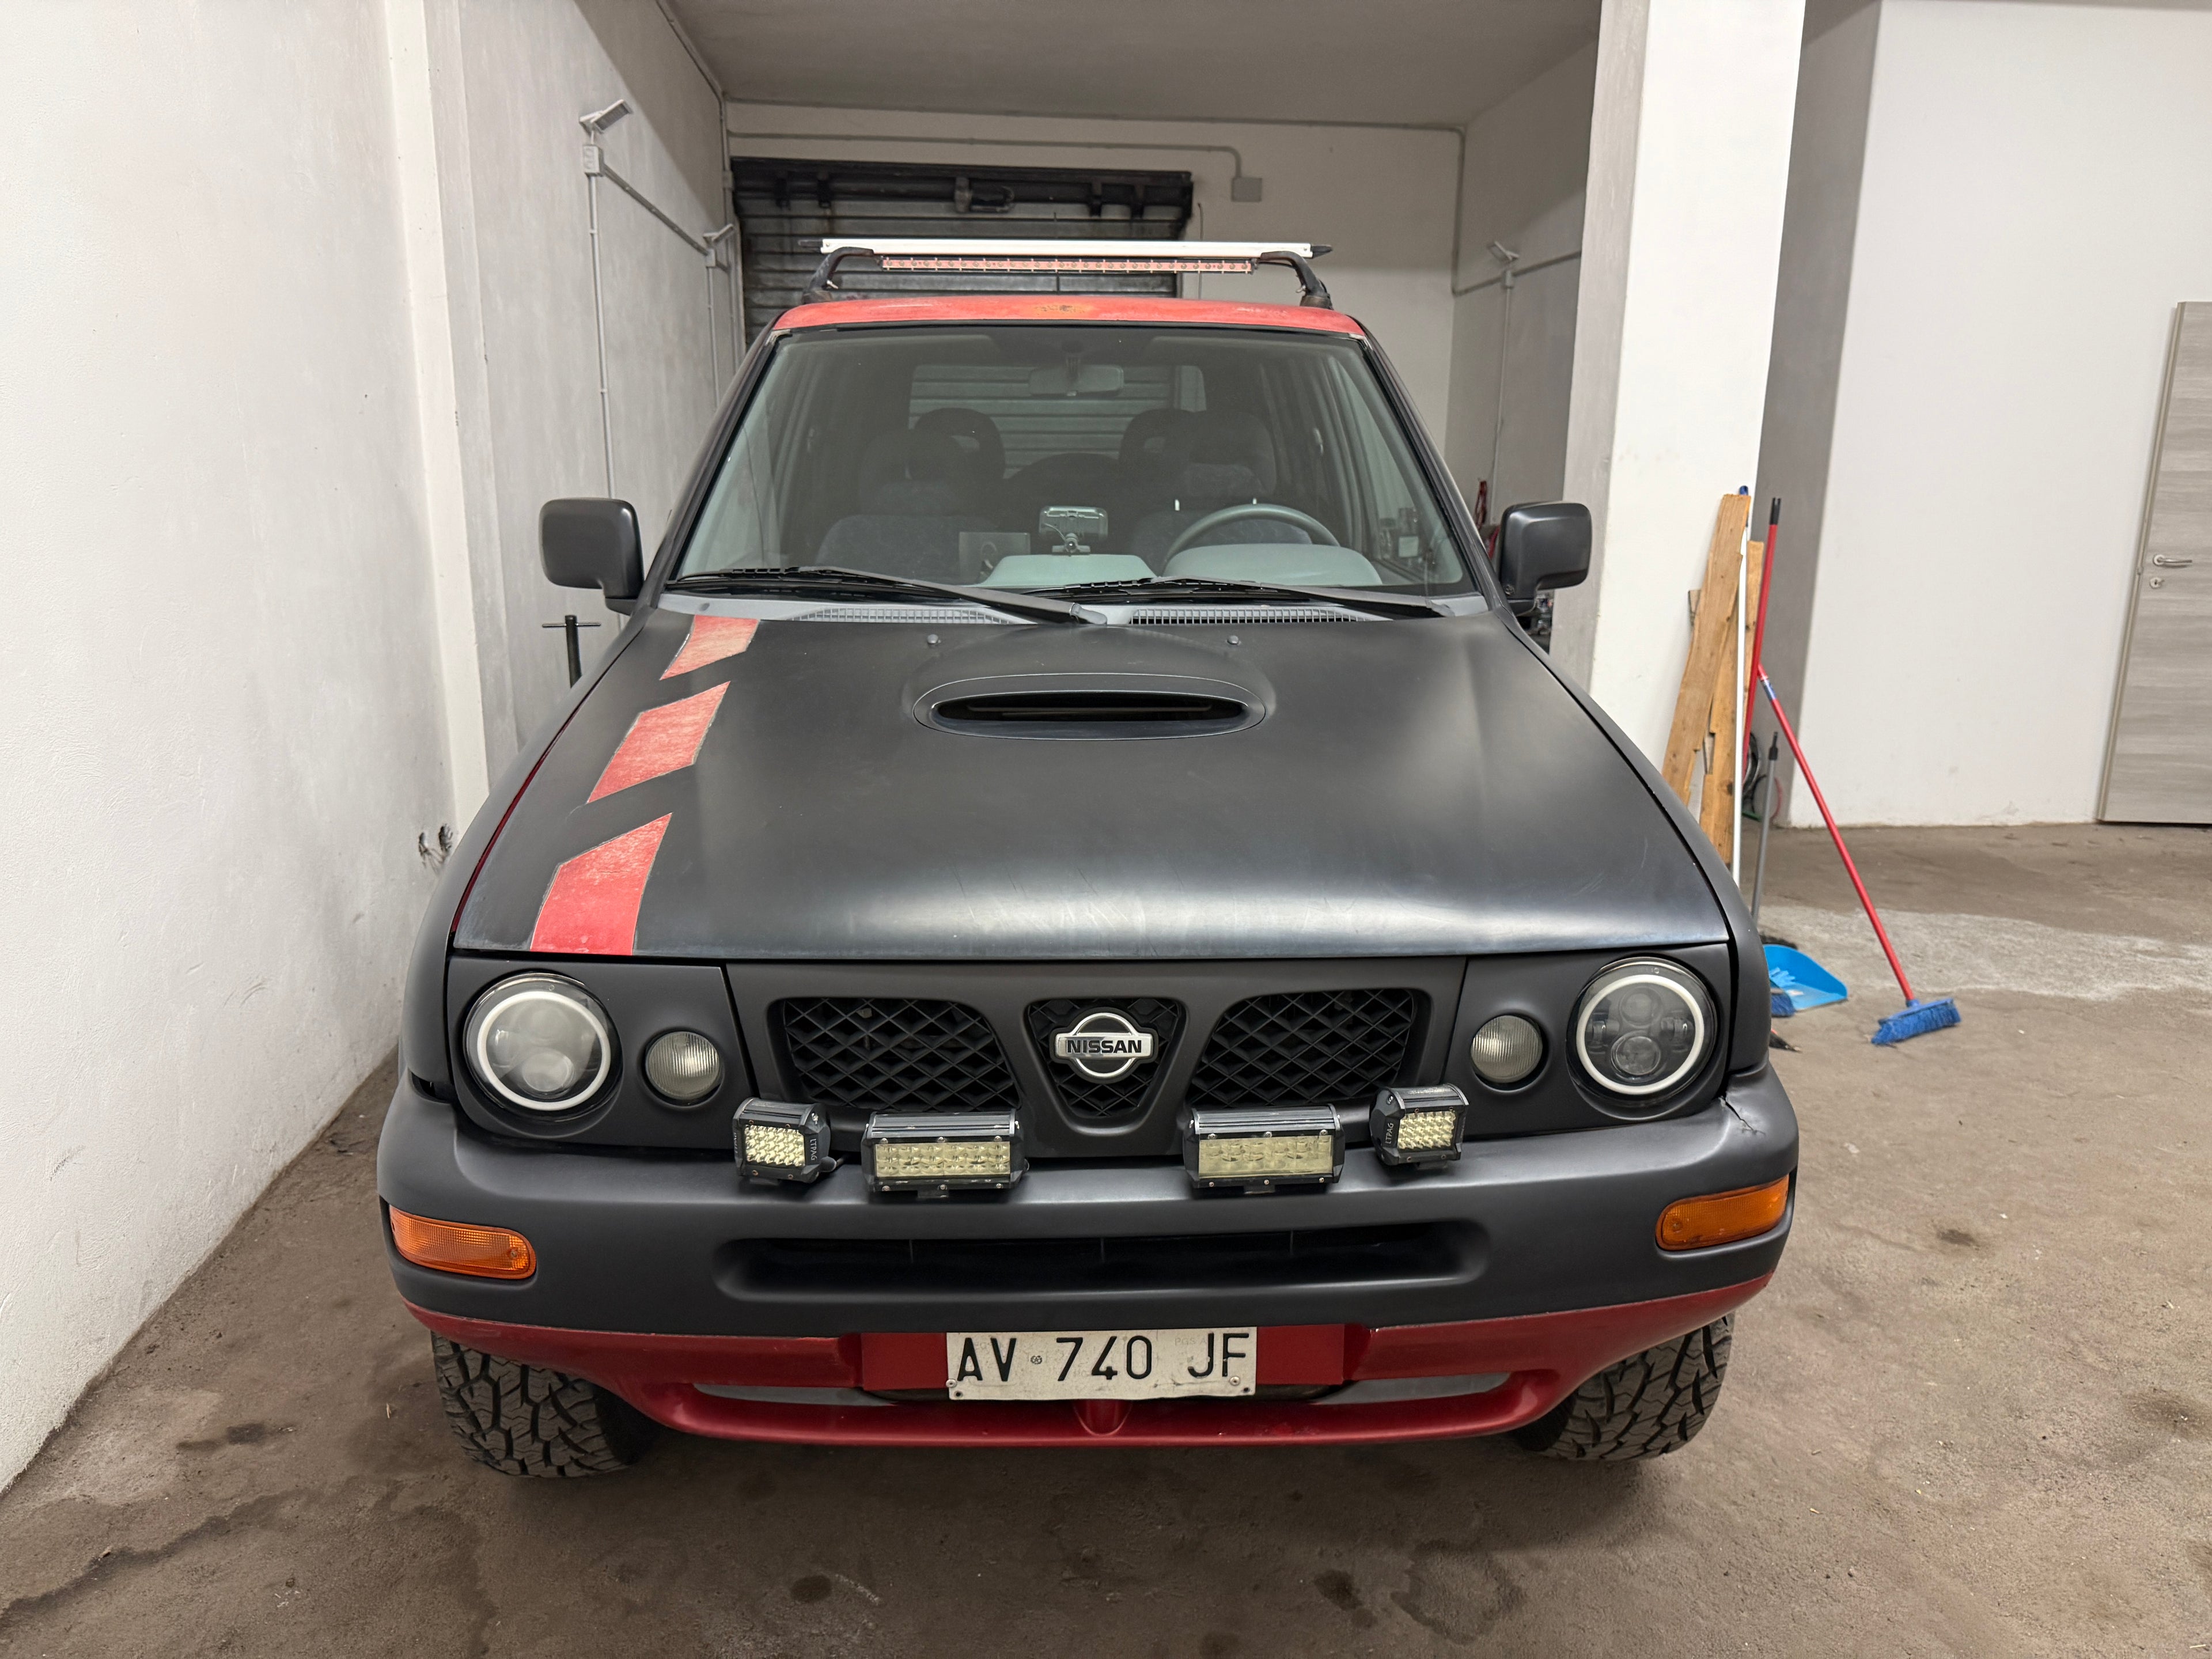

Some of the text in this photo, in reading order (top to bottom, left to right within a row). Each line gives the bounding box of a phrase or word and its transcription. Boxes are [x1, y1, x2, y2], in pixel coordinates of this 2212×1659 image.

[1067, 1040, 1142, 1053] NISSAN
[1385, 1123, 1394, 1144] LTPAG
[957, 1332, 1249, 1382] AV 740 JF
